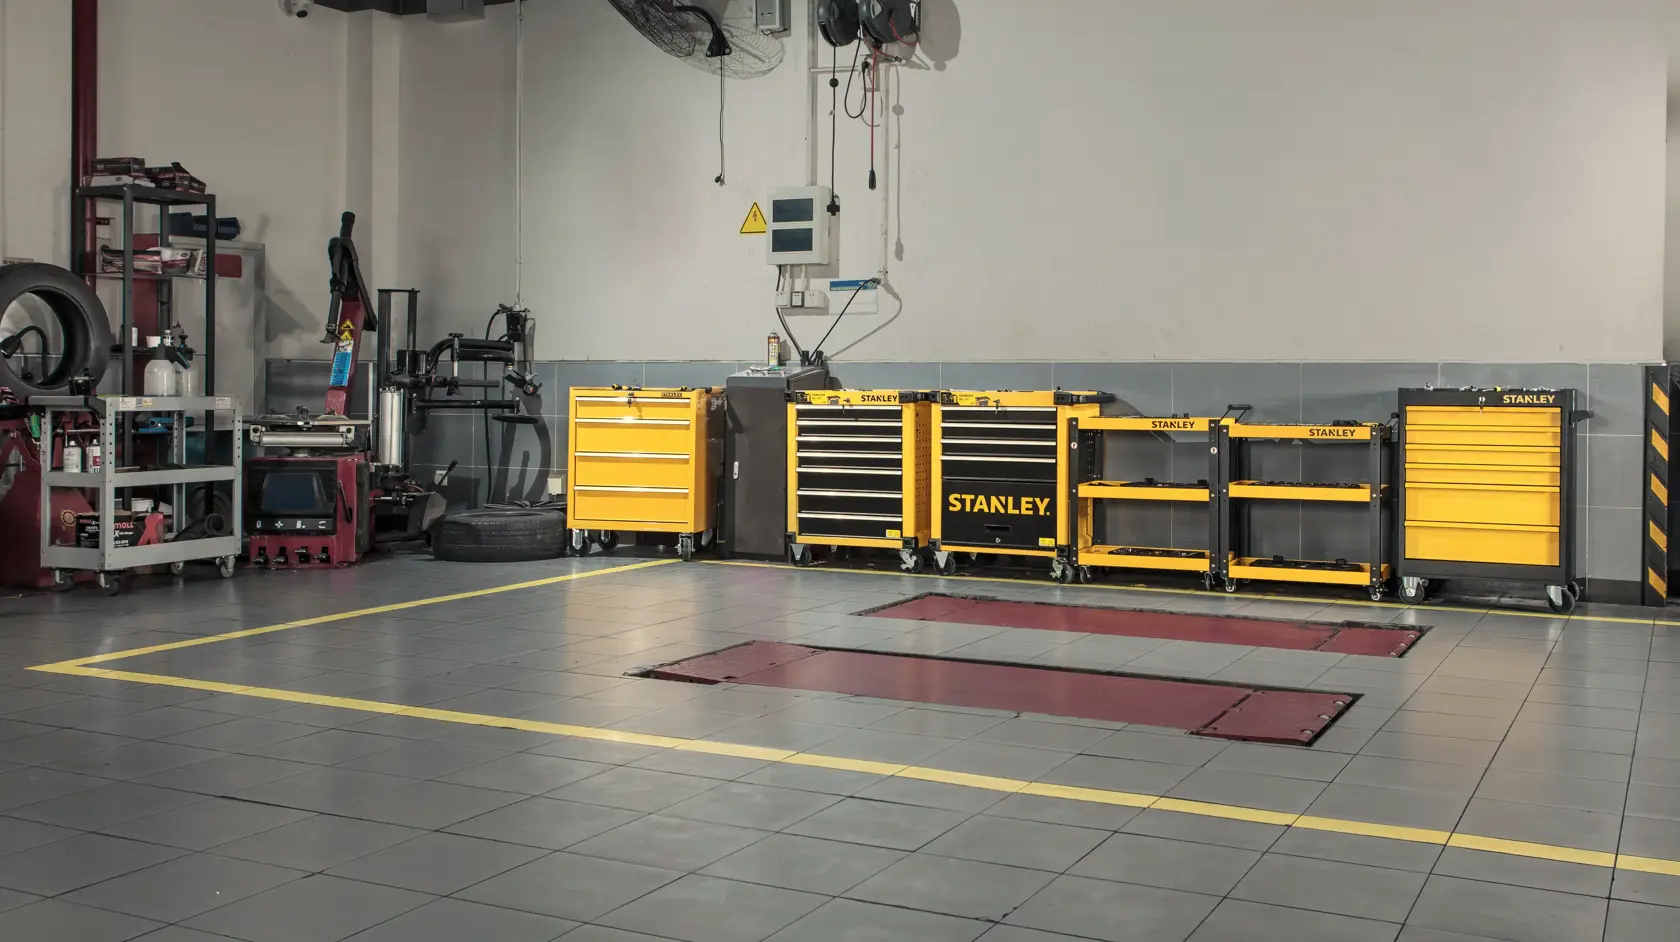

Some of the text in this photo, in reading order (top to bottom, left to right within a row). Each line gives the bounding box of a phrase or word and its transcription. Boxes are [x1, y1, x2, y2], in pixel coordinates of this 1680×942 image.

[861, 394, 898, 403] STANLEY
[1503, 394, 1556, 404] STANLEY
[1151, 420, 1196, 429] STANLEY
[1308, 428, 1356, 437] STANLEY
